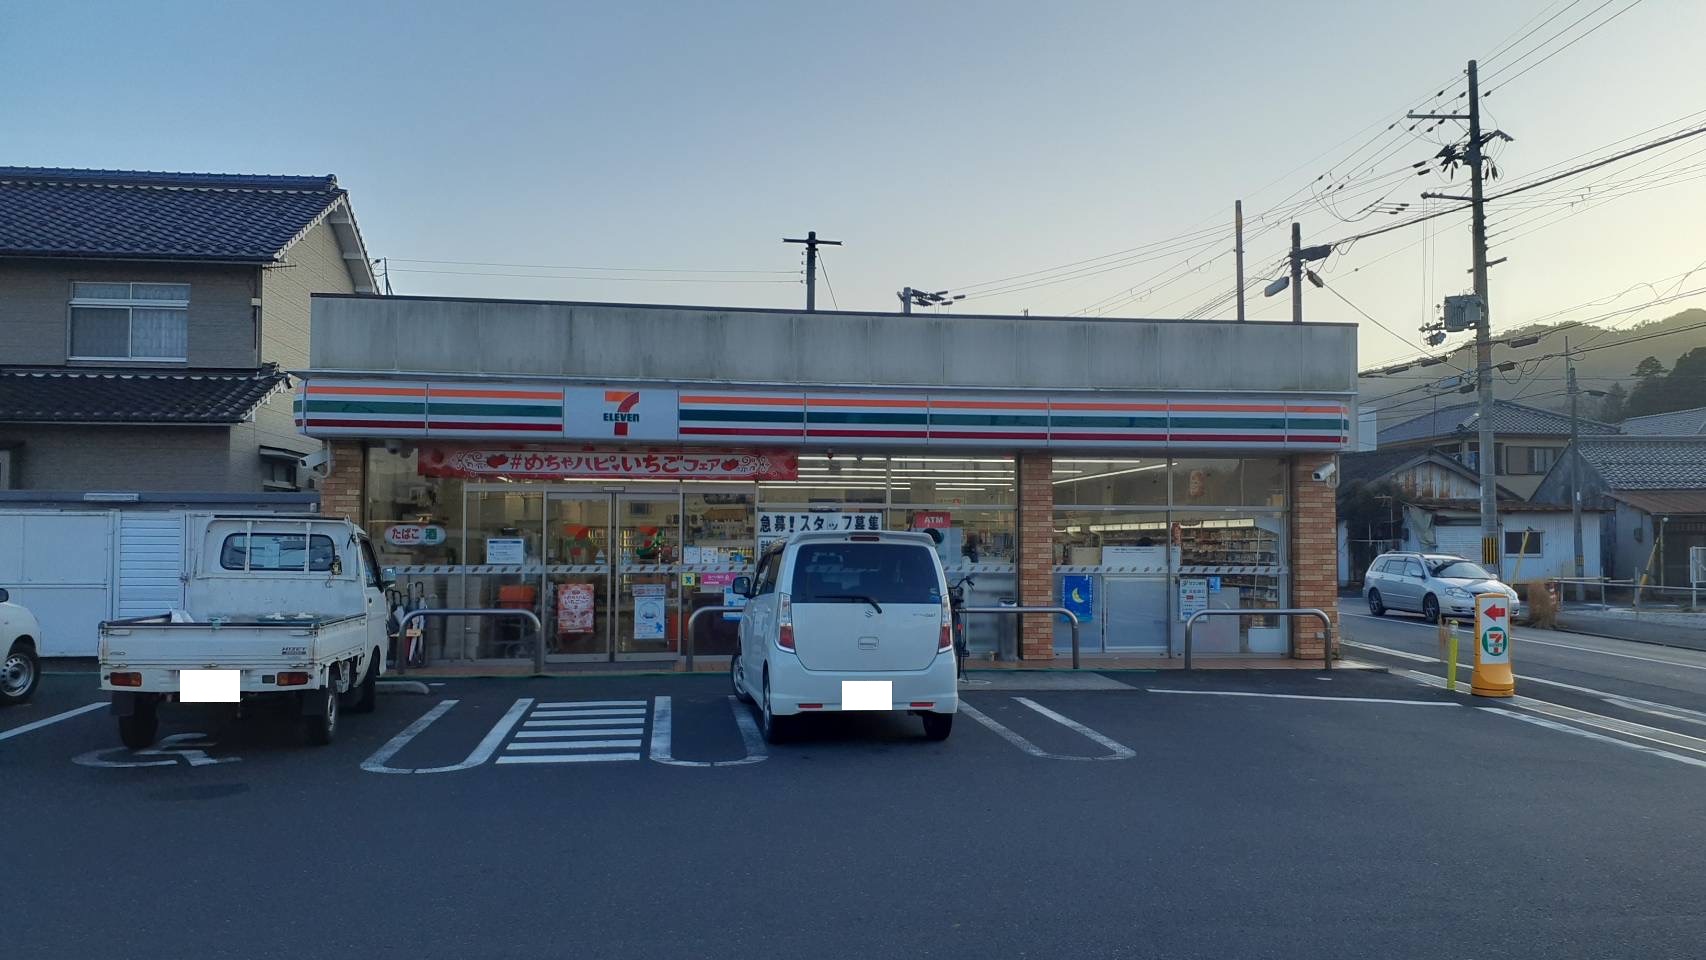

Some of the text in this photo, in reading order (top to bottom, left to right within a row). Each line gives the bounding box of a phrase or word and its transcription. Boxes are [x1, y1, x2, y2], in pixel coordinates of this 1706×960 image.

[604, 391, 640, 436] 7
[924, 516, 944, 524] ATM
[391, 527, 420, 540] たばこ
